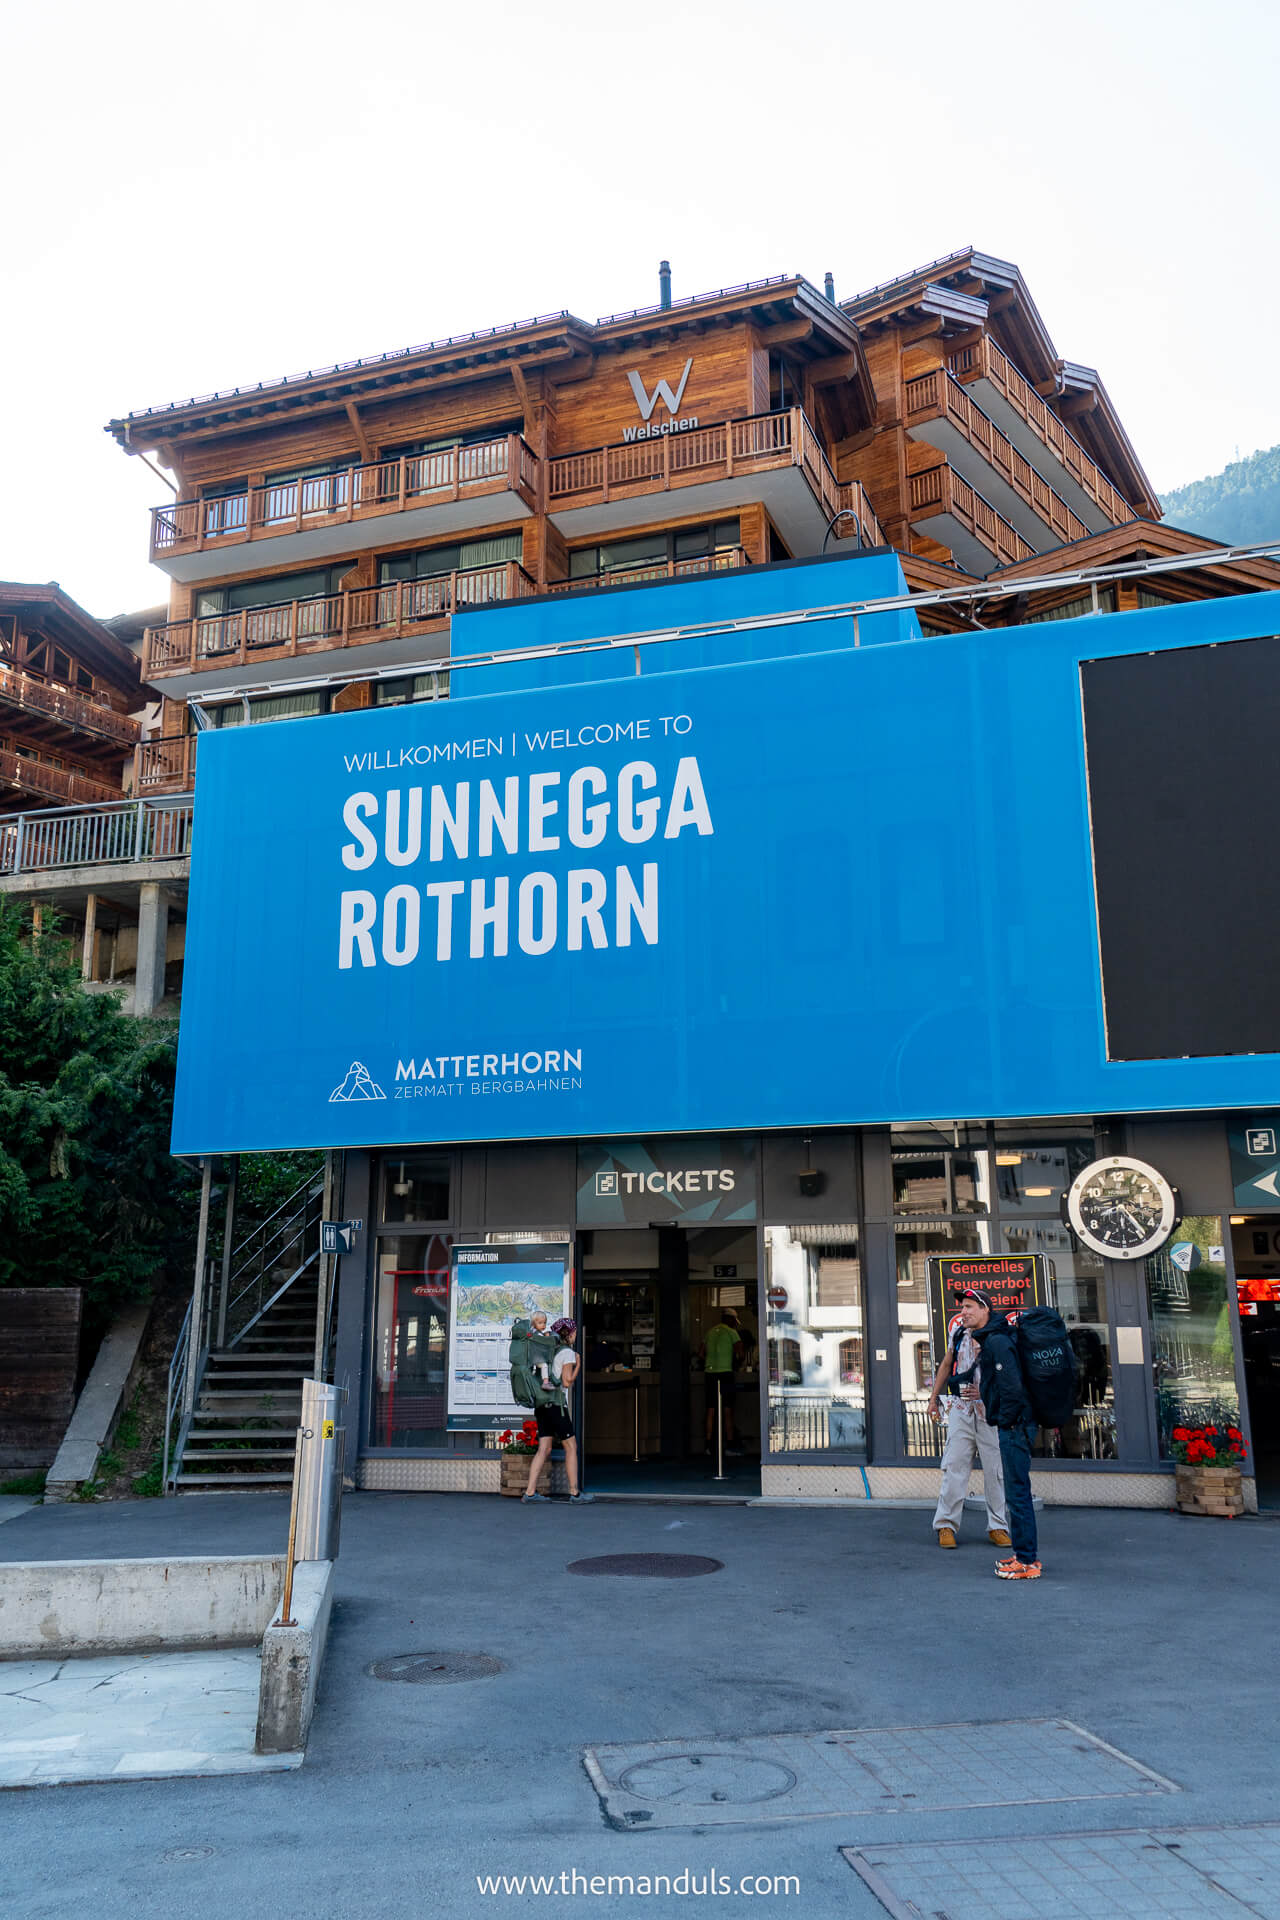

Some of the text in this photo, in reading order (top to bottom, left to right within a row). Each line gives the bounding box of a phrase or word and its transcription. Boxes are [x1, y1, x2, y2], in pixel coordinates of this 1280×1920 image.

[623, 416, 698, 442] Welschen
[344, 714, 693, 773] WILLKOMMEN WELCOME TO
[341, 756, 714, 871] SUNNEGGA
[338, 862, 659, 970] ROTHORN
[394, 1048, 582, 1081] MATTERHORN
[393, 1077, 583, 1100] ZERMATT BERGBAHNEN
[621, 1168, 735, 1194] TICKETS
[1110, 1171, 1125, 1182] 12
[1087, 1187, 1101, 1198] 10
[1141, 1183, 1150, 1193] 2
[1090, 1219, 1098, 1230] 8
[1147, 1216, 1155, 1227] 4
[457, 1252, 499, 1263] INFORMATION
[951, 1260, 1024, 1274] Generelles
[946, 1276, 1032, 1291] Feuerverbot
[1032, 1347, 1063, 1360] NOVA
